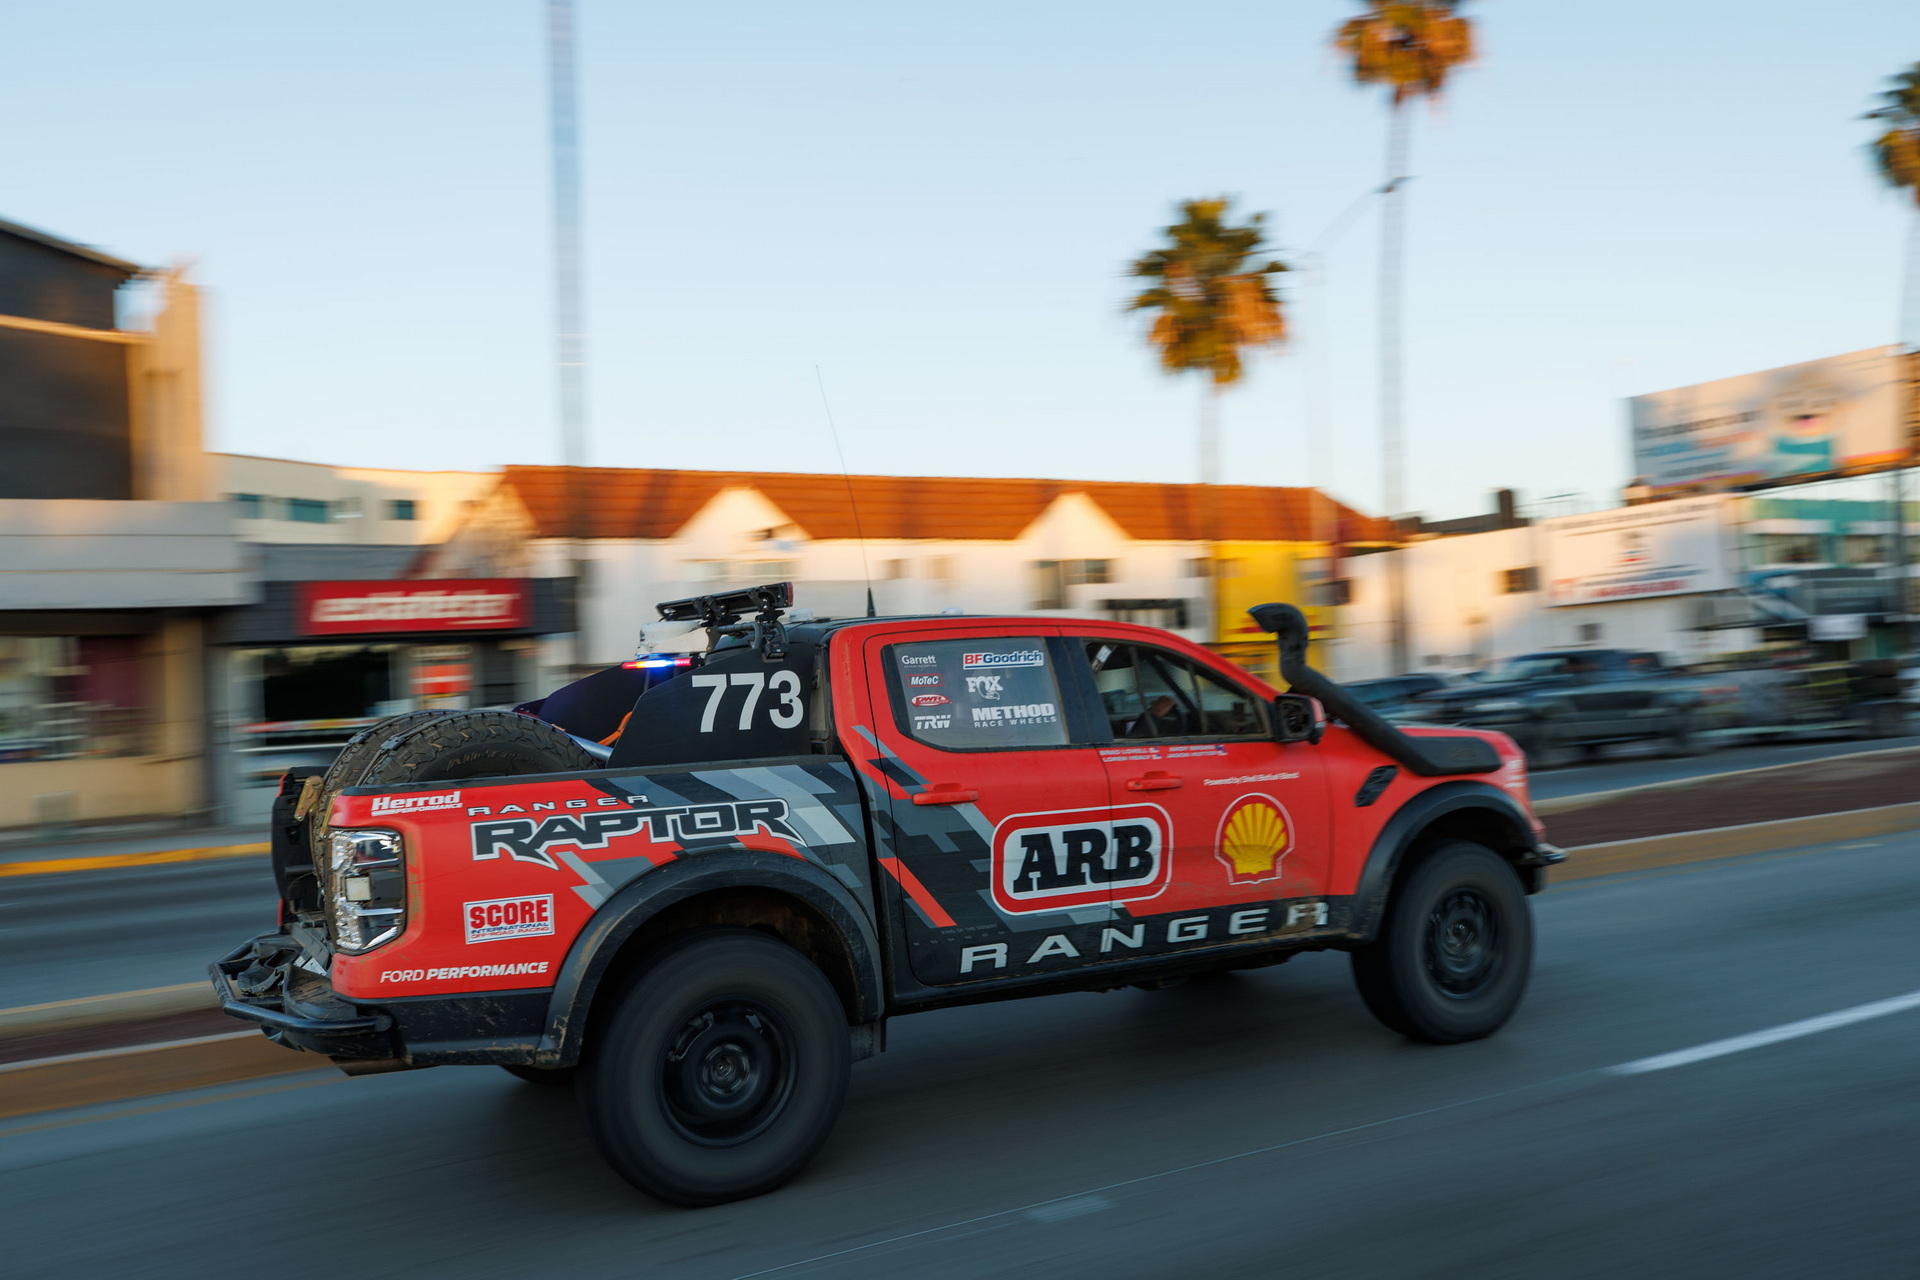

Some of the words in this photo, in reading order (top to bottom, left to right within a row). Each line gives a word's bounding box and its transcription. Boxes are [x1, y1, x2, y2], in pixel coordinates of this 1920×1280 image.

[902, 655, 936, 664] Garrett
[964, 651, 1043, 665] BFGoodrich
[911, 676, 940, 686] MoTeC
[966, 676, 1004, 698] FOX
[692, 670, 804, 733] 773
[914, 714, 951, 730] TRW
[971, 704, 1056, 721] METHOD
[974, 719, 1004, 728] RACE
[1010, 716, 1057, 726] WHEELS
[371, 791, 461, 811] Herrod
[396, 803, 463, 814] PERFORMANCE
[467, 795, 649, 817] RANGER
[468, 798, 808, 870] RAPTOR
[1013, 824, 1153, 893] ARB
[470, 899, 548, 929] SCORE
[470, 922, 549, 934] INTERNATIONAL
[960, 902, 1329, 973] RANGER
[380, 968, 424, 984] FORD
[426, 962, 549, 981] PERFORMANCE
